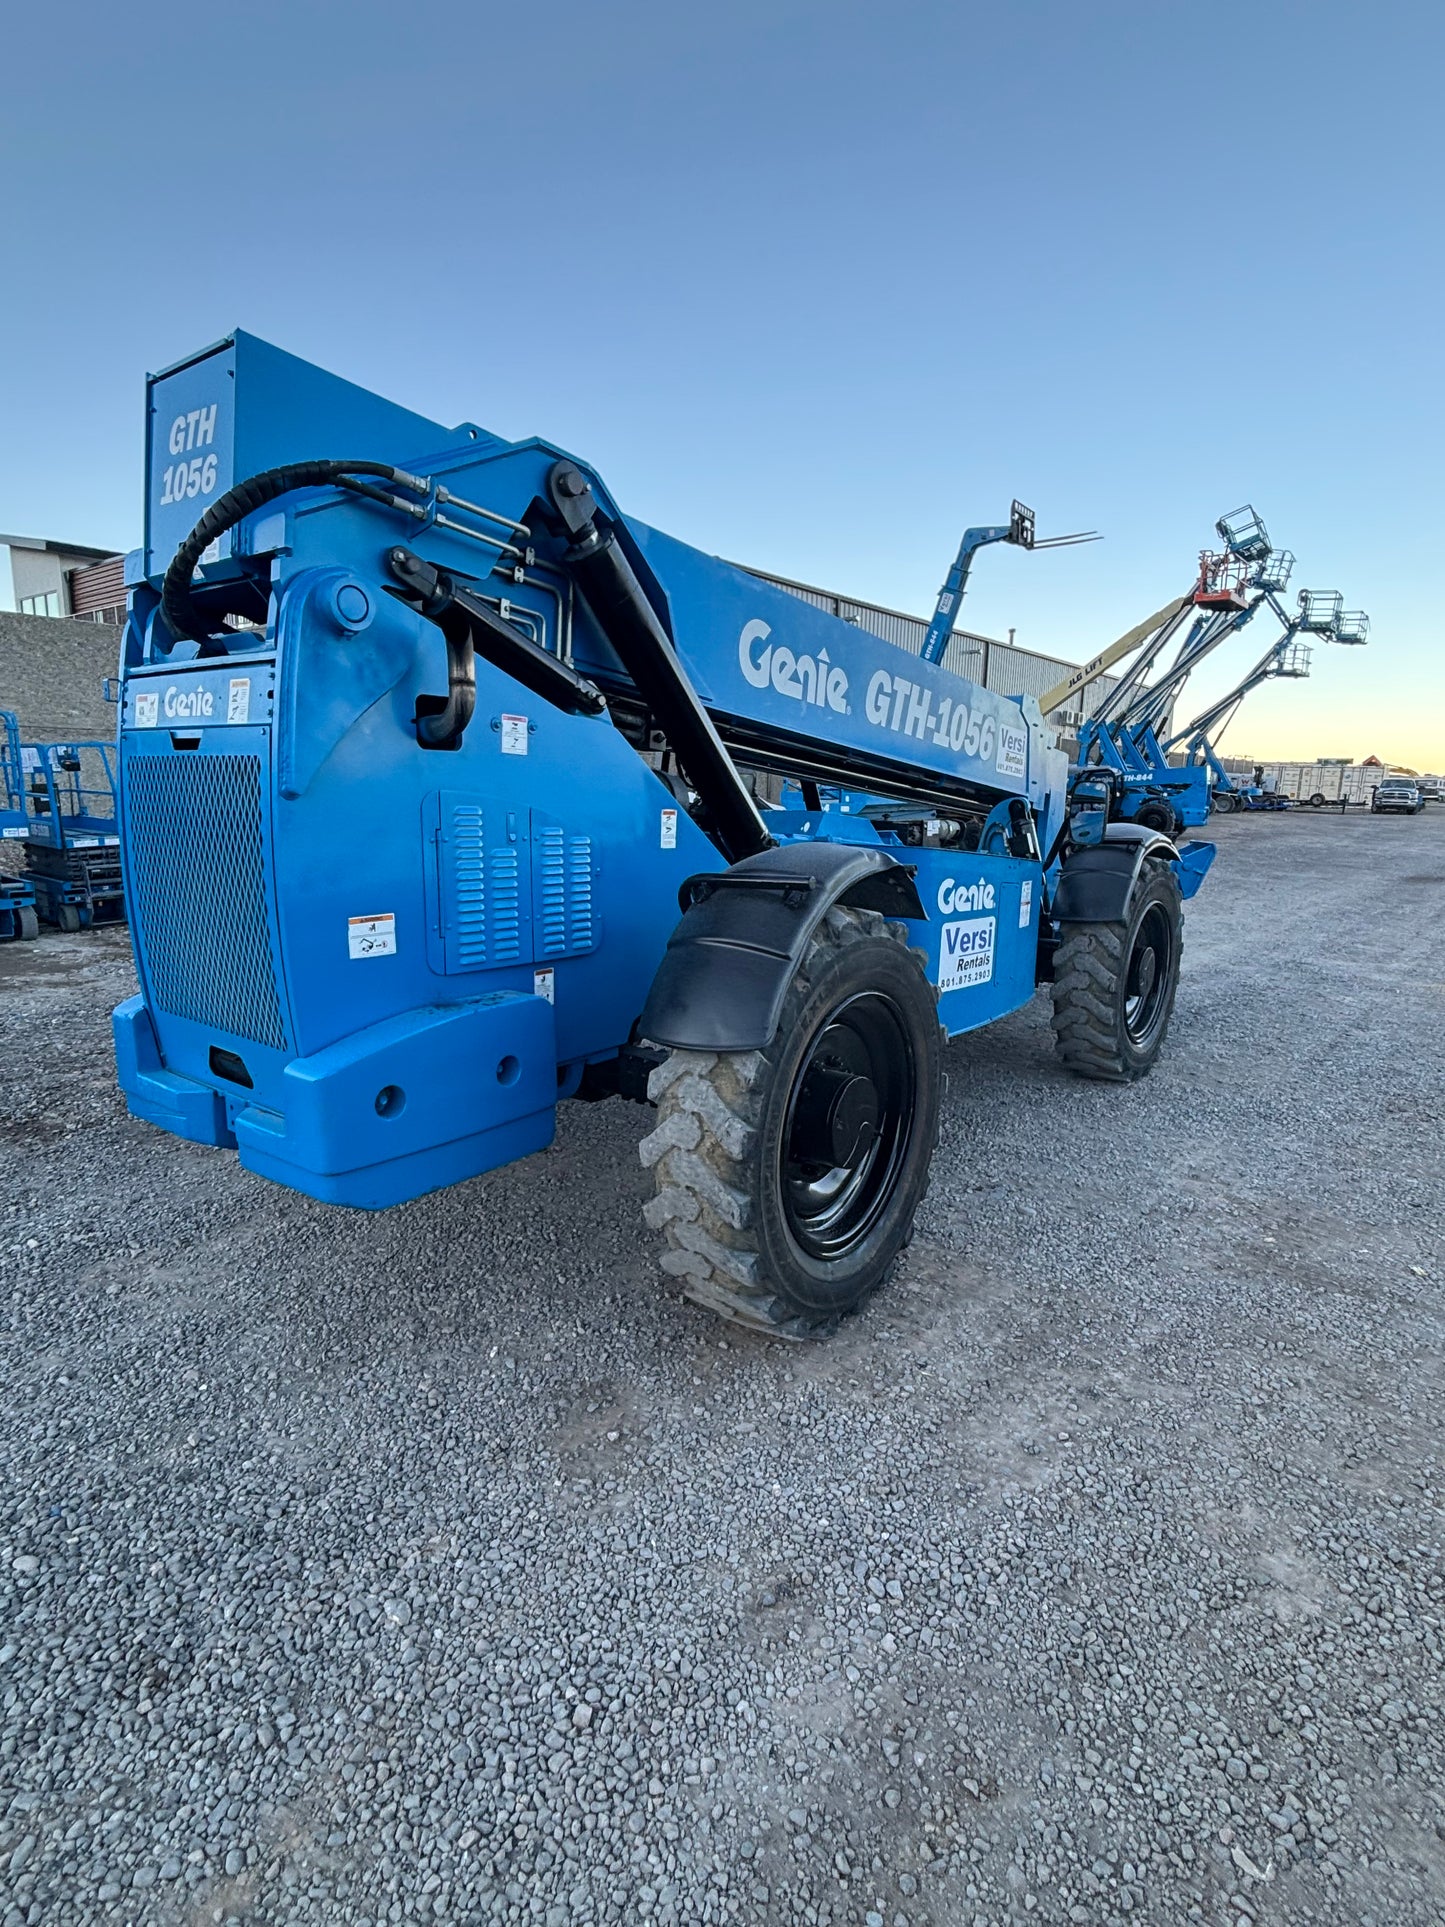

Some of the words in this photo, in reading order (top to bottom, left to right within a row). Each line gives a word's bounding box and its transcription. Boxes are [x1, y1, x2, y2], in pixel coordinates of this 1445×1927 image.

[169, 404, 217, 456] GTH
[160, 453, 218, 505] 1056
[1068, 672, 1083, 689] JLG
[1084, 656, 1103, 676] LIFT
[164, 685, 213, 718] Genie
[739, 619, 849, 714] Genie
[865, 669, 996, 761] GTH-1056
[1001, 727, 1026, 754] Versi
[937, 876, 996, 915] Genie
[945, 922, 993, 955] Versi
[941, 969, 991, 988] 801.875.2903
[956, 952, 991, 972] Rentals
